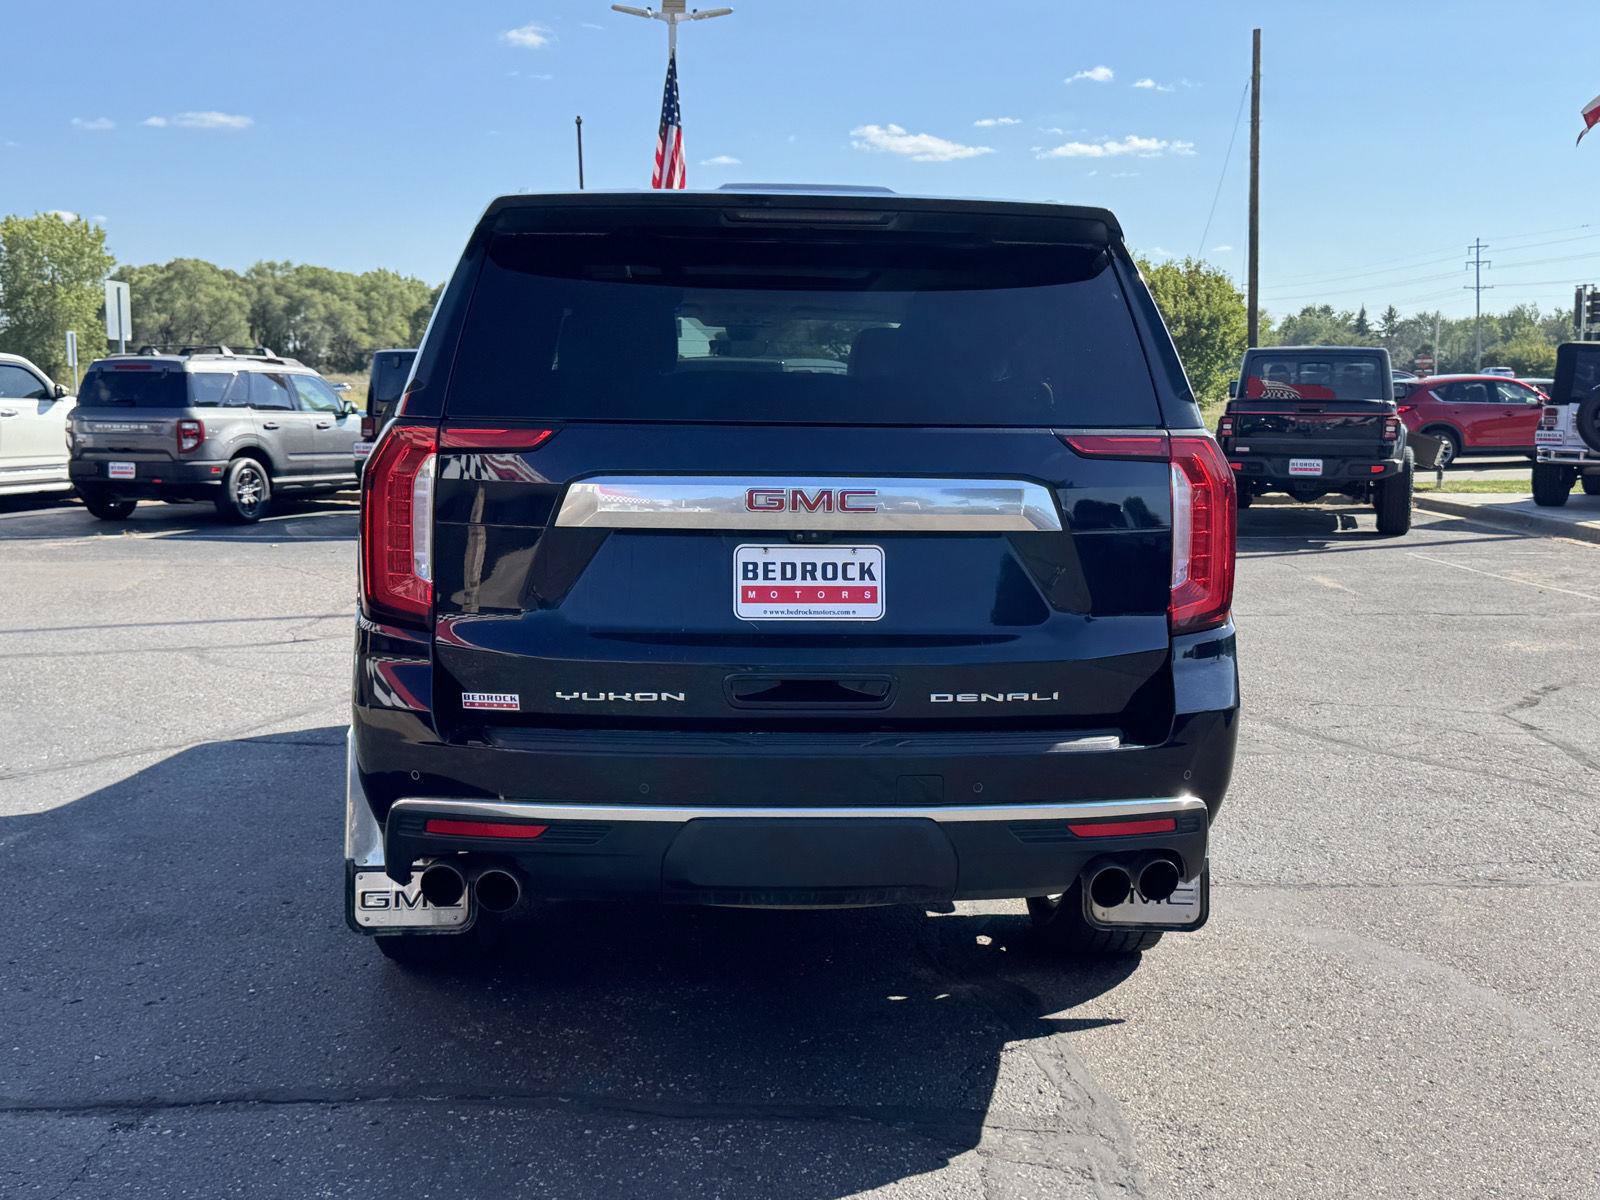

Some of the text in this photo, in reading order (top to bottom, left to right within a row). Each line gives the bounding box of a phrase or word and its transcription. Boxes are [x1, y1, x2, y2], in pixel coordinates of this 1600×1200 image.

[746, 488, 878, 513] GMC
[742, 561, 877, 582] BEDROCK
[747, 590, 872, 599] MOTORS
[463, 694, 517, 702] BEDROCK
[555, 691, 685, 701] YUKON
[930, 691, 1059, 702] DENALI
[359, 889, 463, 910] GM
